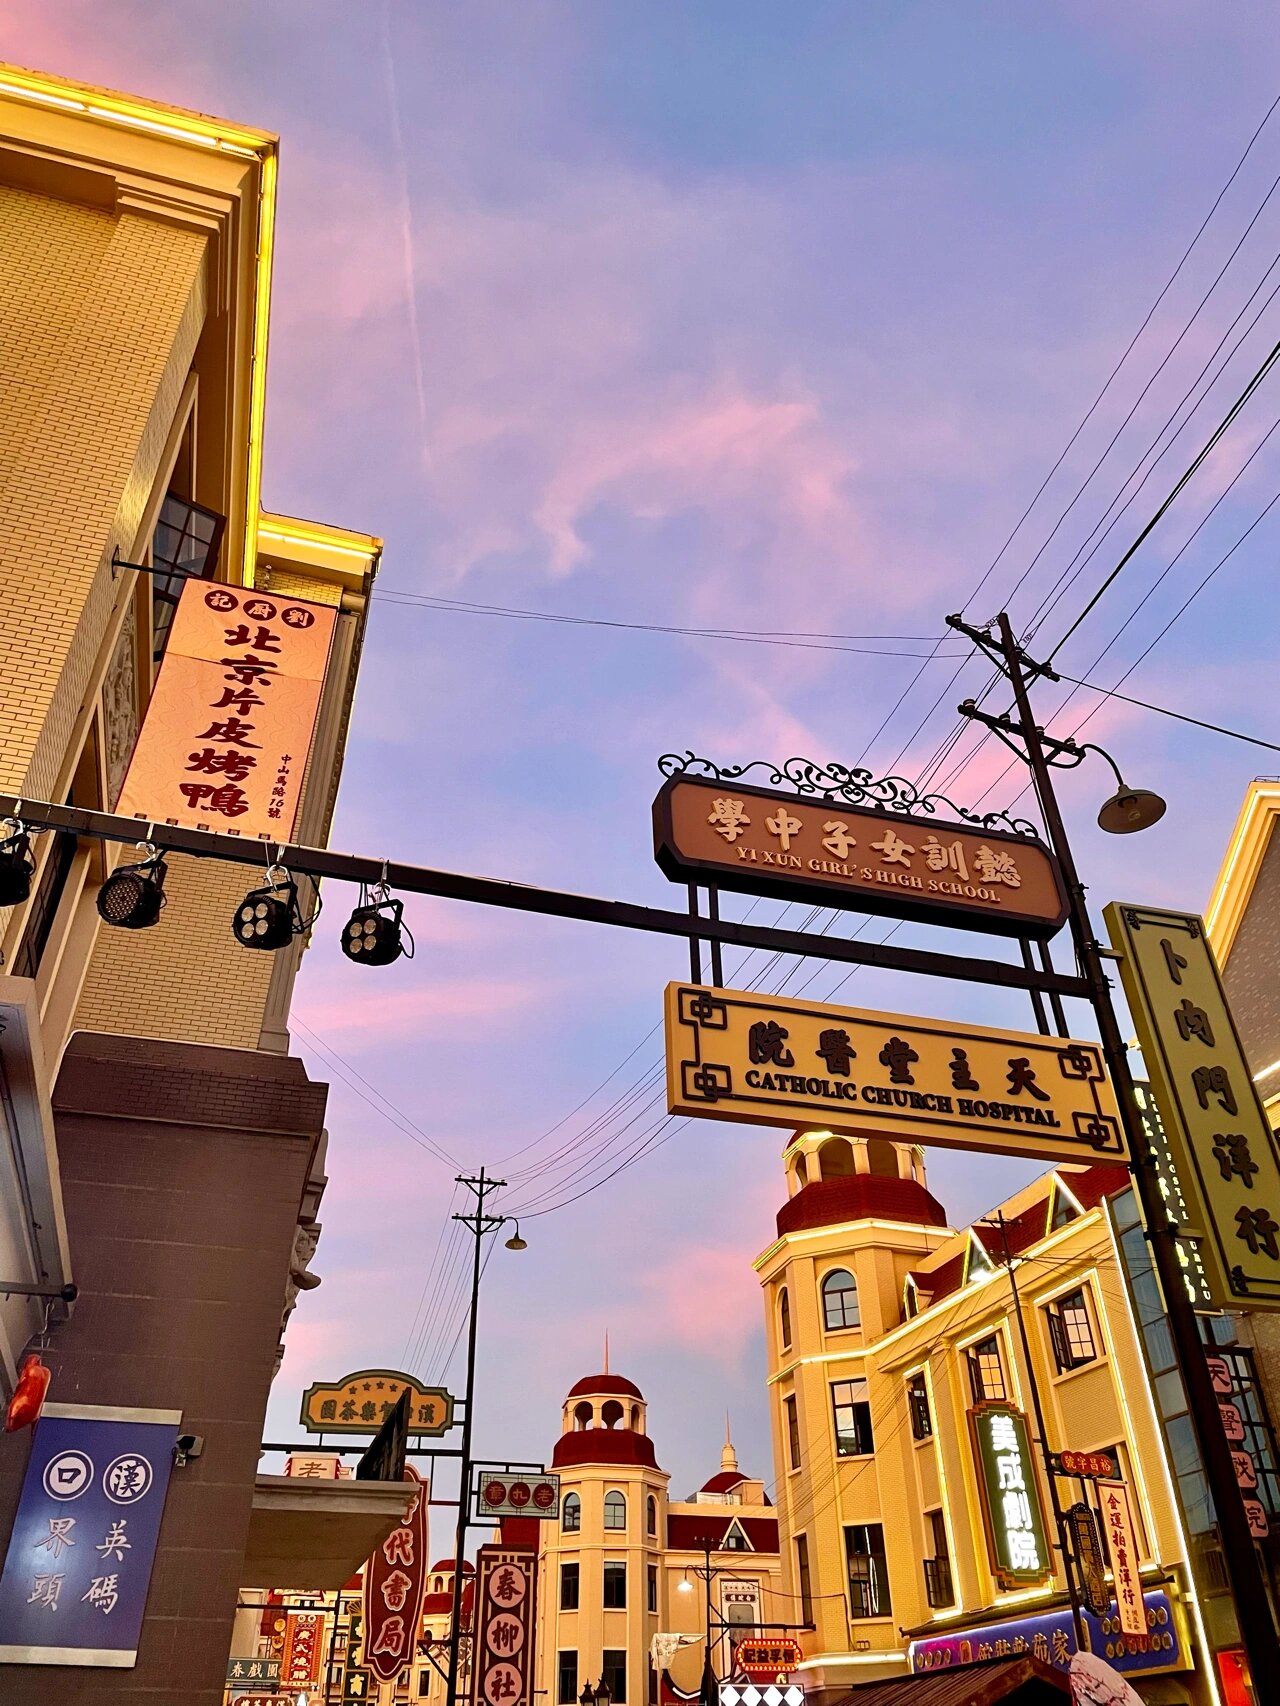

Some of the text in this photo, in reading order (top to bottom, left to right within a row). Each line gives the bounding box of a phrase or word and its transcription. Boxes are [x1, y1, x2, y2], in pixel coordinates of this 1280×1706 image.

[179, 624, 282, 817] 北京片皮烤鴨
[735, 846, 758, 861] YI
[761, 851, 802, 868] XUN
[875, 870, 924, 890] HIGH
[928, 879, 1001, 902] SCHOOL
[745, 1070, 1061, 1128] CATHOLIC CHURCH HOSPITAL
[1189, 1240, 1211, 1301] UREAU
[490, 1568, 523, 1702] 春柳社
